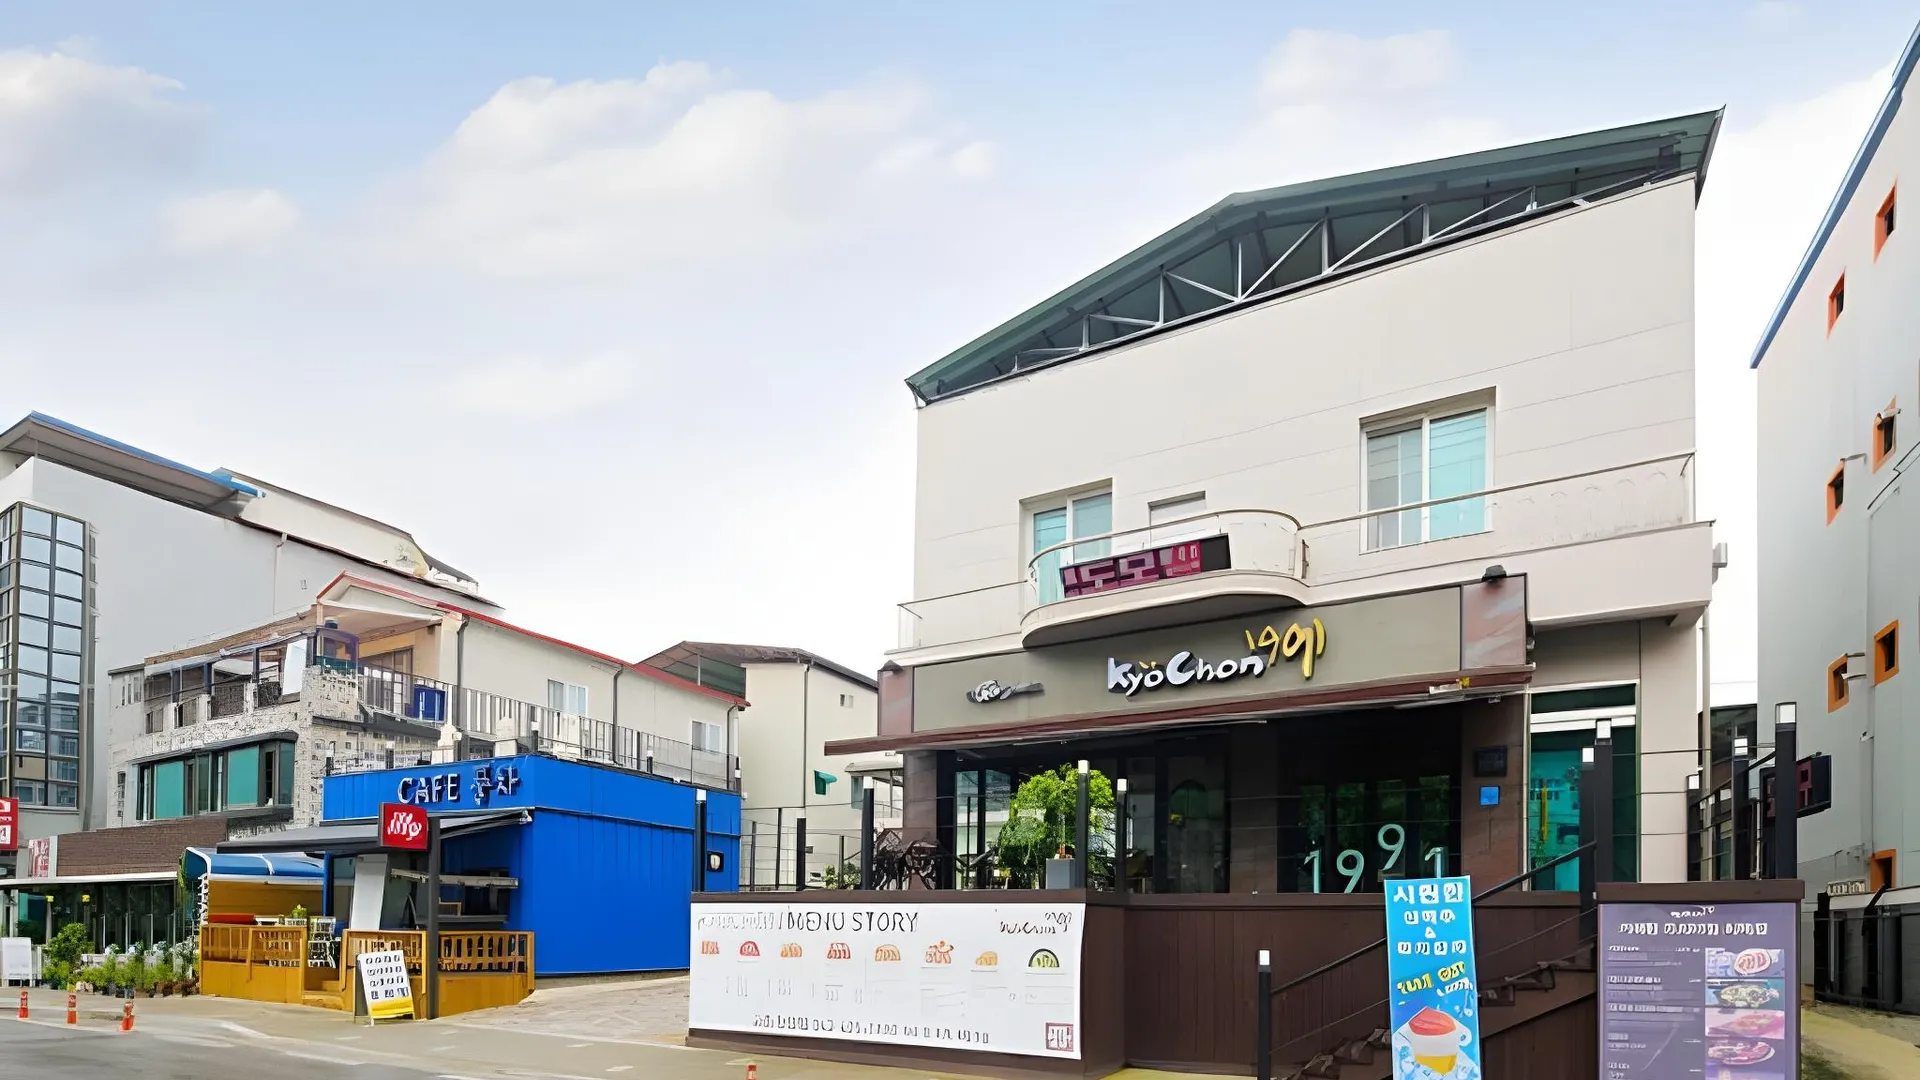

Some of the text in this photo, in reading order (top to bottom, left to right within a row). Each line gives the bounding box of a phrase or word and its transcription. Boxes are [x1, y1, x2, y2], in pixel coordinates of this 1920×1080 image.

[397, 773, 459, 804] CAFE
[1303, 823, 1445, 894] 1991
[851, 911, 919, 933] STORY
